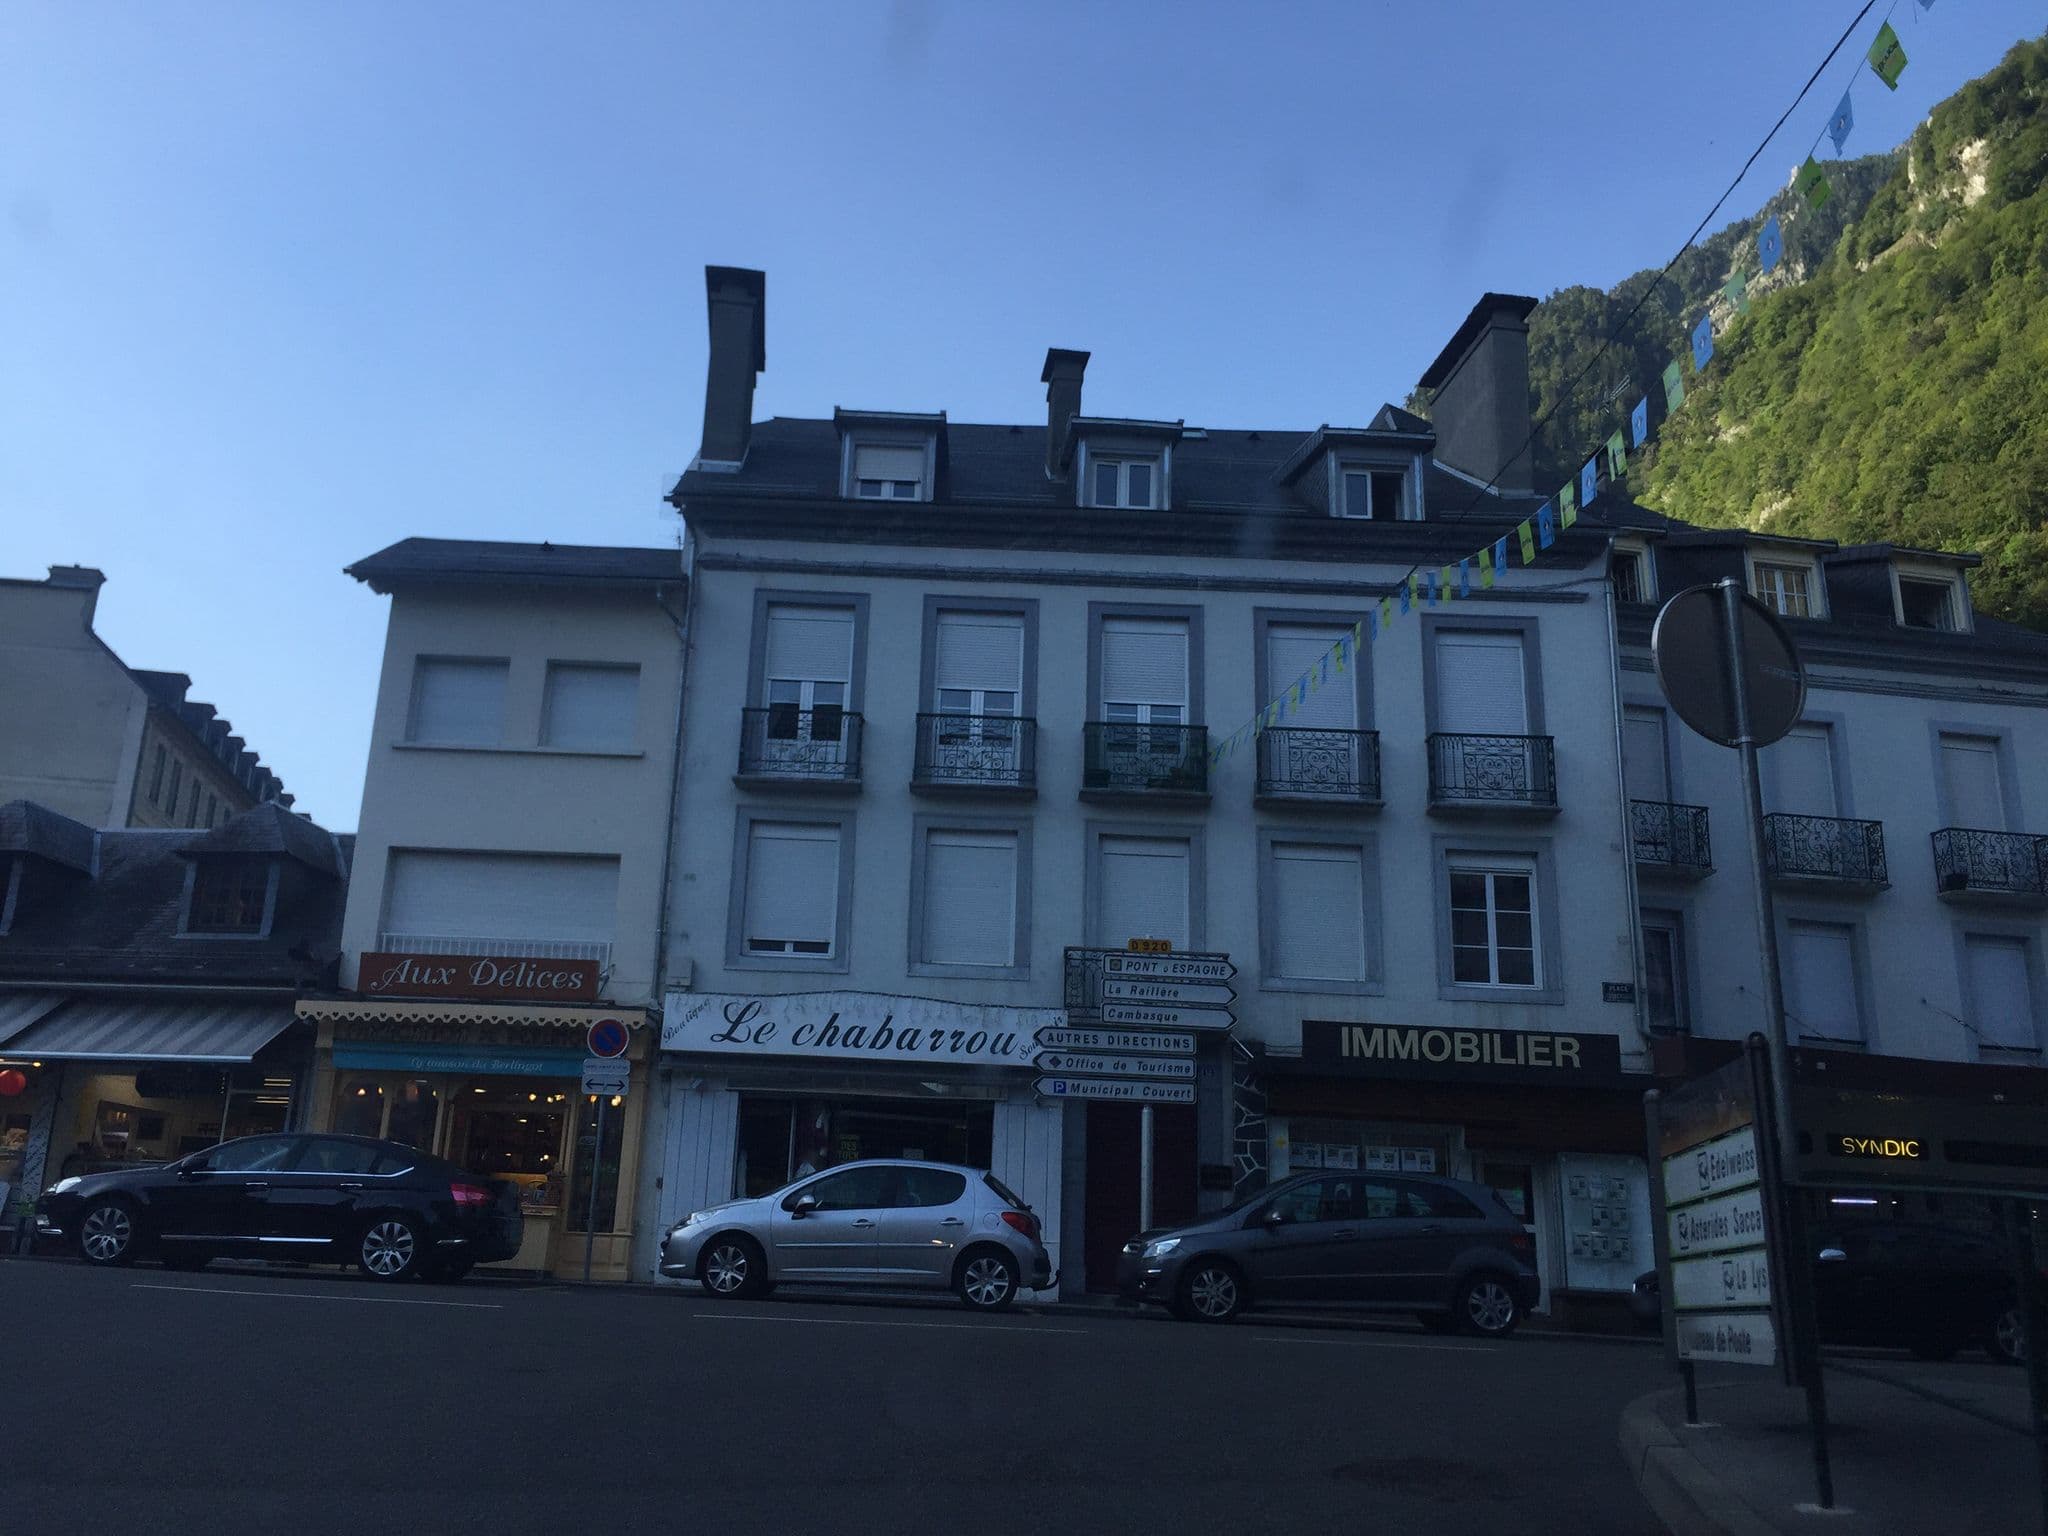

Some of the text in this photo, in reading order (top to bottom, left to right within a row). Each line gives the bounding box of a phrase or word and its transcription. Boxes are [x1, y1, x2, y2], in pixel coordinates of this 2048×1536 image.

[1143, 941, 1168, 951] 920
[370, 957, 584, 991] Aux Délices
[1126, 961, 1158, 972] PONT
[1108, 984, 1121, 993] La
[1108, 1008, 1179, 1022] Cambasque
[710, 1000, 1020, 1056] Le chabarrou
[1047, 1033, 1190, 1048] AUTRES DIRECTIONS
[1341, 1025, 1582, 1069] IMMOBILIER
[1066, 1058, 1103, 1070] Office
[1113, 1060, 1127, 1070] de
[1137, 1061, 1191, 1074] Tourisme
[1071, 1083, 1134, 1097] Municipal
[1142, 1086, 1191, 1098] Couvert
[1842, 1137, 1920, 1158] SYNDIC
[1711, 1149, 1755, 1181] Edelweiss
[1736, 1261, 1767, 1294] Le Lys
